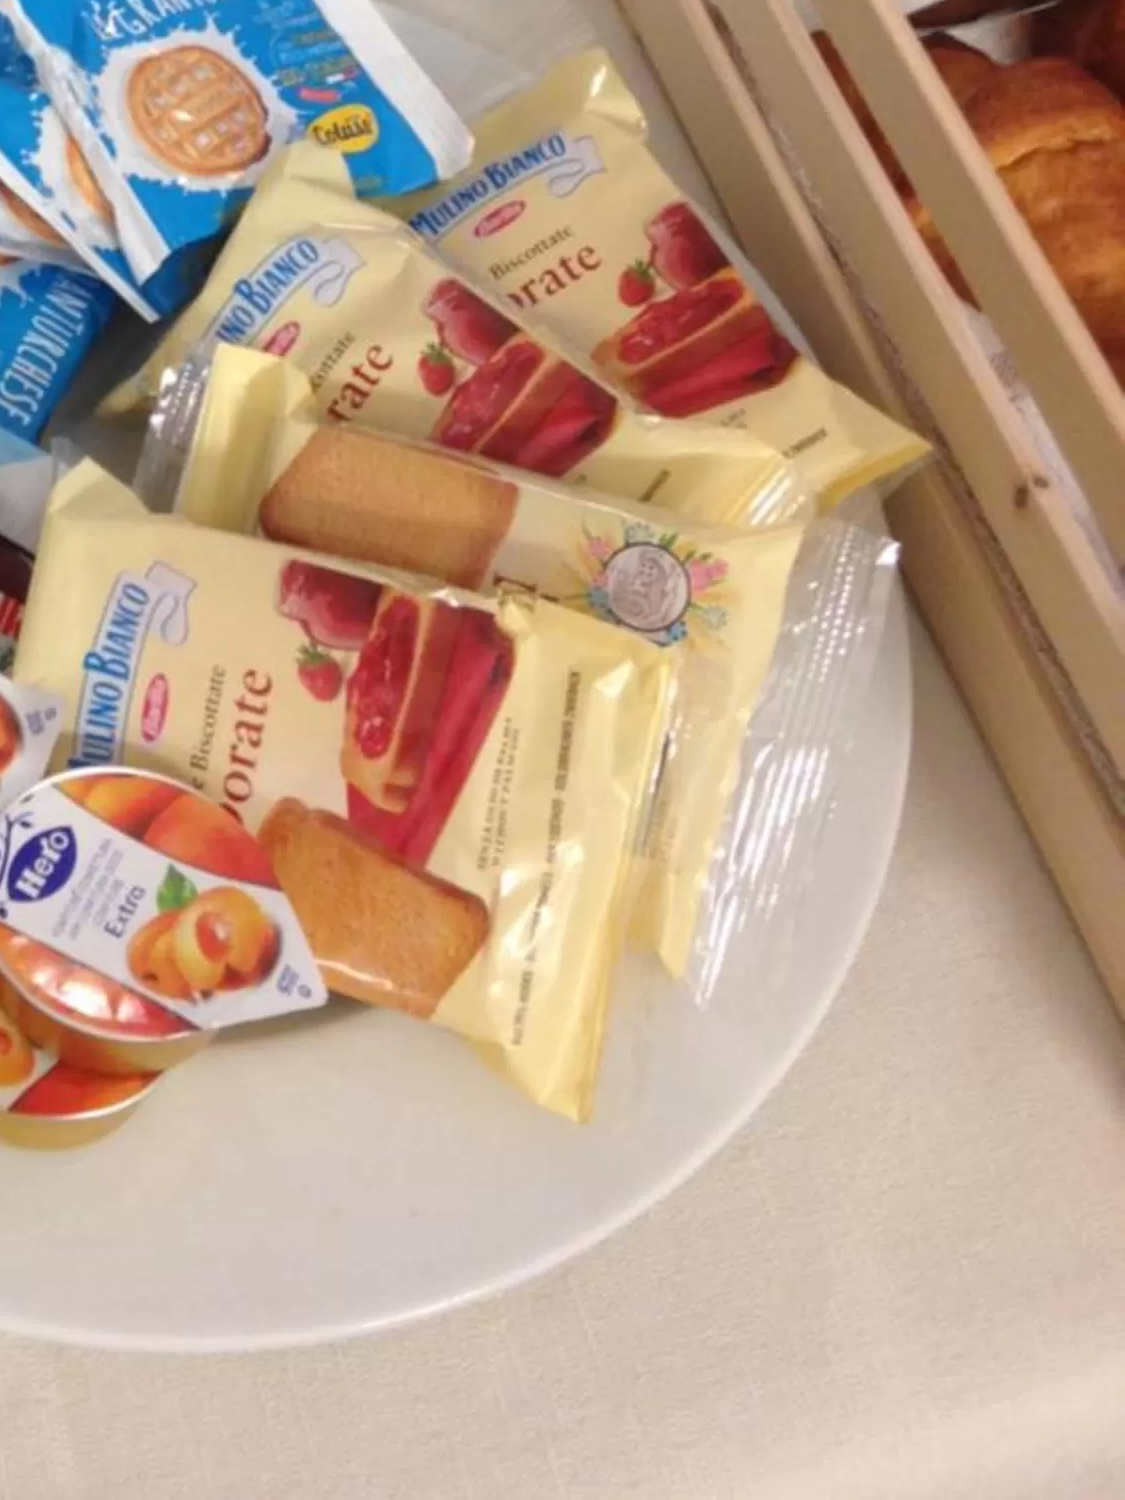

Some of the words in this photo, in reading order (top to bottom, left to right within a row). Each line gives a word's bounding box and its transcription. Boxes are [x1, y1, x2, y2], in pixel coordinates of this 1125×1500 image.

[409, 180, 489, 236] MULINO
[483, 132, 567, 189] BIANCO
[232, 239, 320, 316] BIANCO
[488, 225, 573, 281] Biscottate
[506, 245, 603, 309] rate
[215, 304, 256, 344] INO
[326, 343, 394, 422] rate
[83, 582, 150, 681] BIANCO
[189, 663, 227, 771] Biscottate
[15, 830, 70, 899] Hero
[103, 884, 147, 940] Extra
